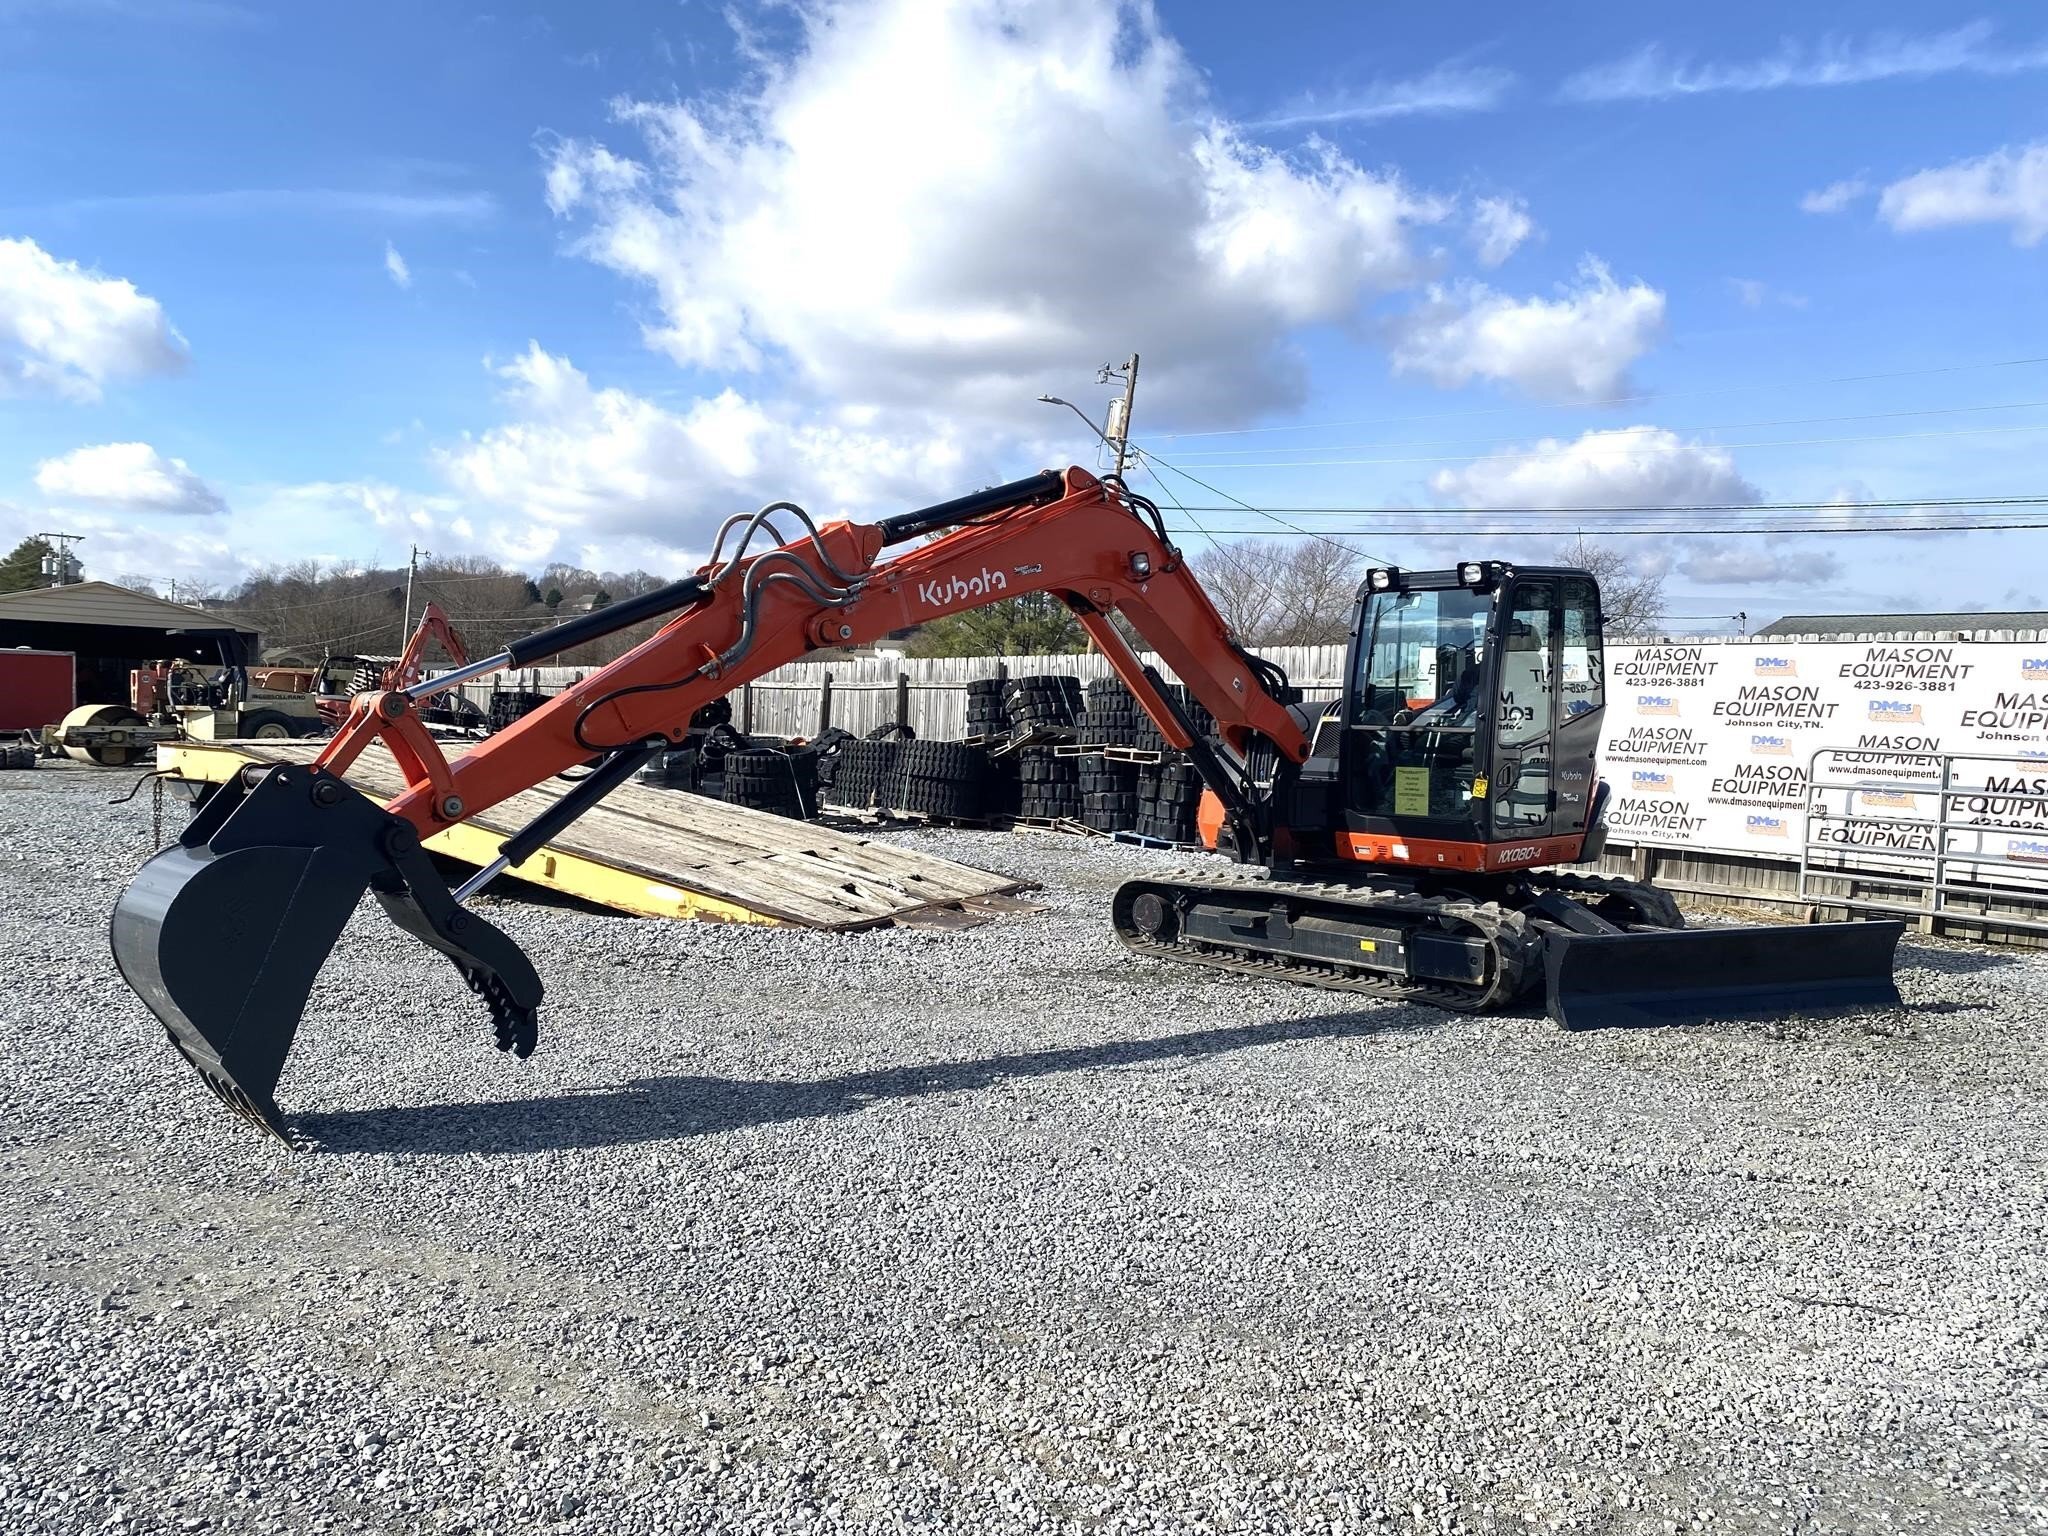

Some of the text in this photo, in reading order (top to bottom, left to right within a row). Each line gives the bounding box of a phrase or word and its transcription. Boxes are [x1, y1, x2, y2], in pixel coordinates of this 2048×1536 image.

[918, 567, 1007, 606] Kubota
[1635, 648, 1702, 661] MASON
[1865, 648, 1953, 663] MASON
[1613, 662, 1719, 676] EQUIPMENT
[1838, 663, 1975, 679] EQUIPMENT
[1625, 678, 1705, 687] 423-926-3881
[1853, 680, 1955, 691] 423-926-3881
[1738, 686, 1820, 701] MASON
[1713, 702, 1840, 718] EQUIPMENT
[1725, 719, 1773, 728] Johnson
[1960, 710, 2048, 730] EQUIP
[1628, 727, 1693, 741] MASON
[1976, 731, 2040, 742] Johnson
[1608, 739, 1709, 755] EQUIPMENT
[1858, 735, 1941, 751] MASON
[1604, 754, 1708, 767] www.dmasonequipment.com
[1831, 752, 1942, 767] EQUIPMEN
[1734, 764, 1809, 782] MASON
[1828, 765, 1959, 780] www.dmasonequipment.m
[1984, 776, 2048, 796] MAS
[1619, 798, 1690, 816] MASON
[1498, 846, 1542, 863] KX080-4
